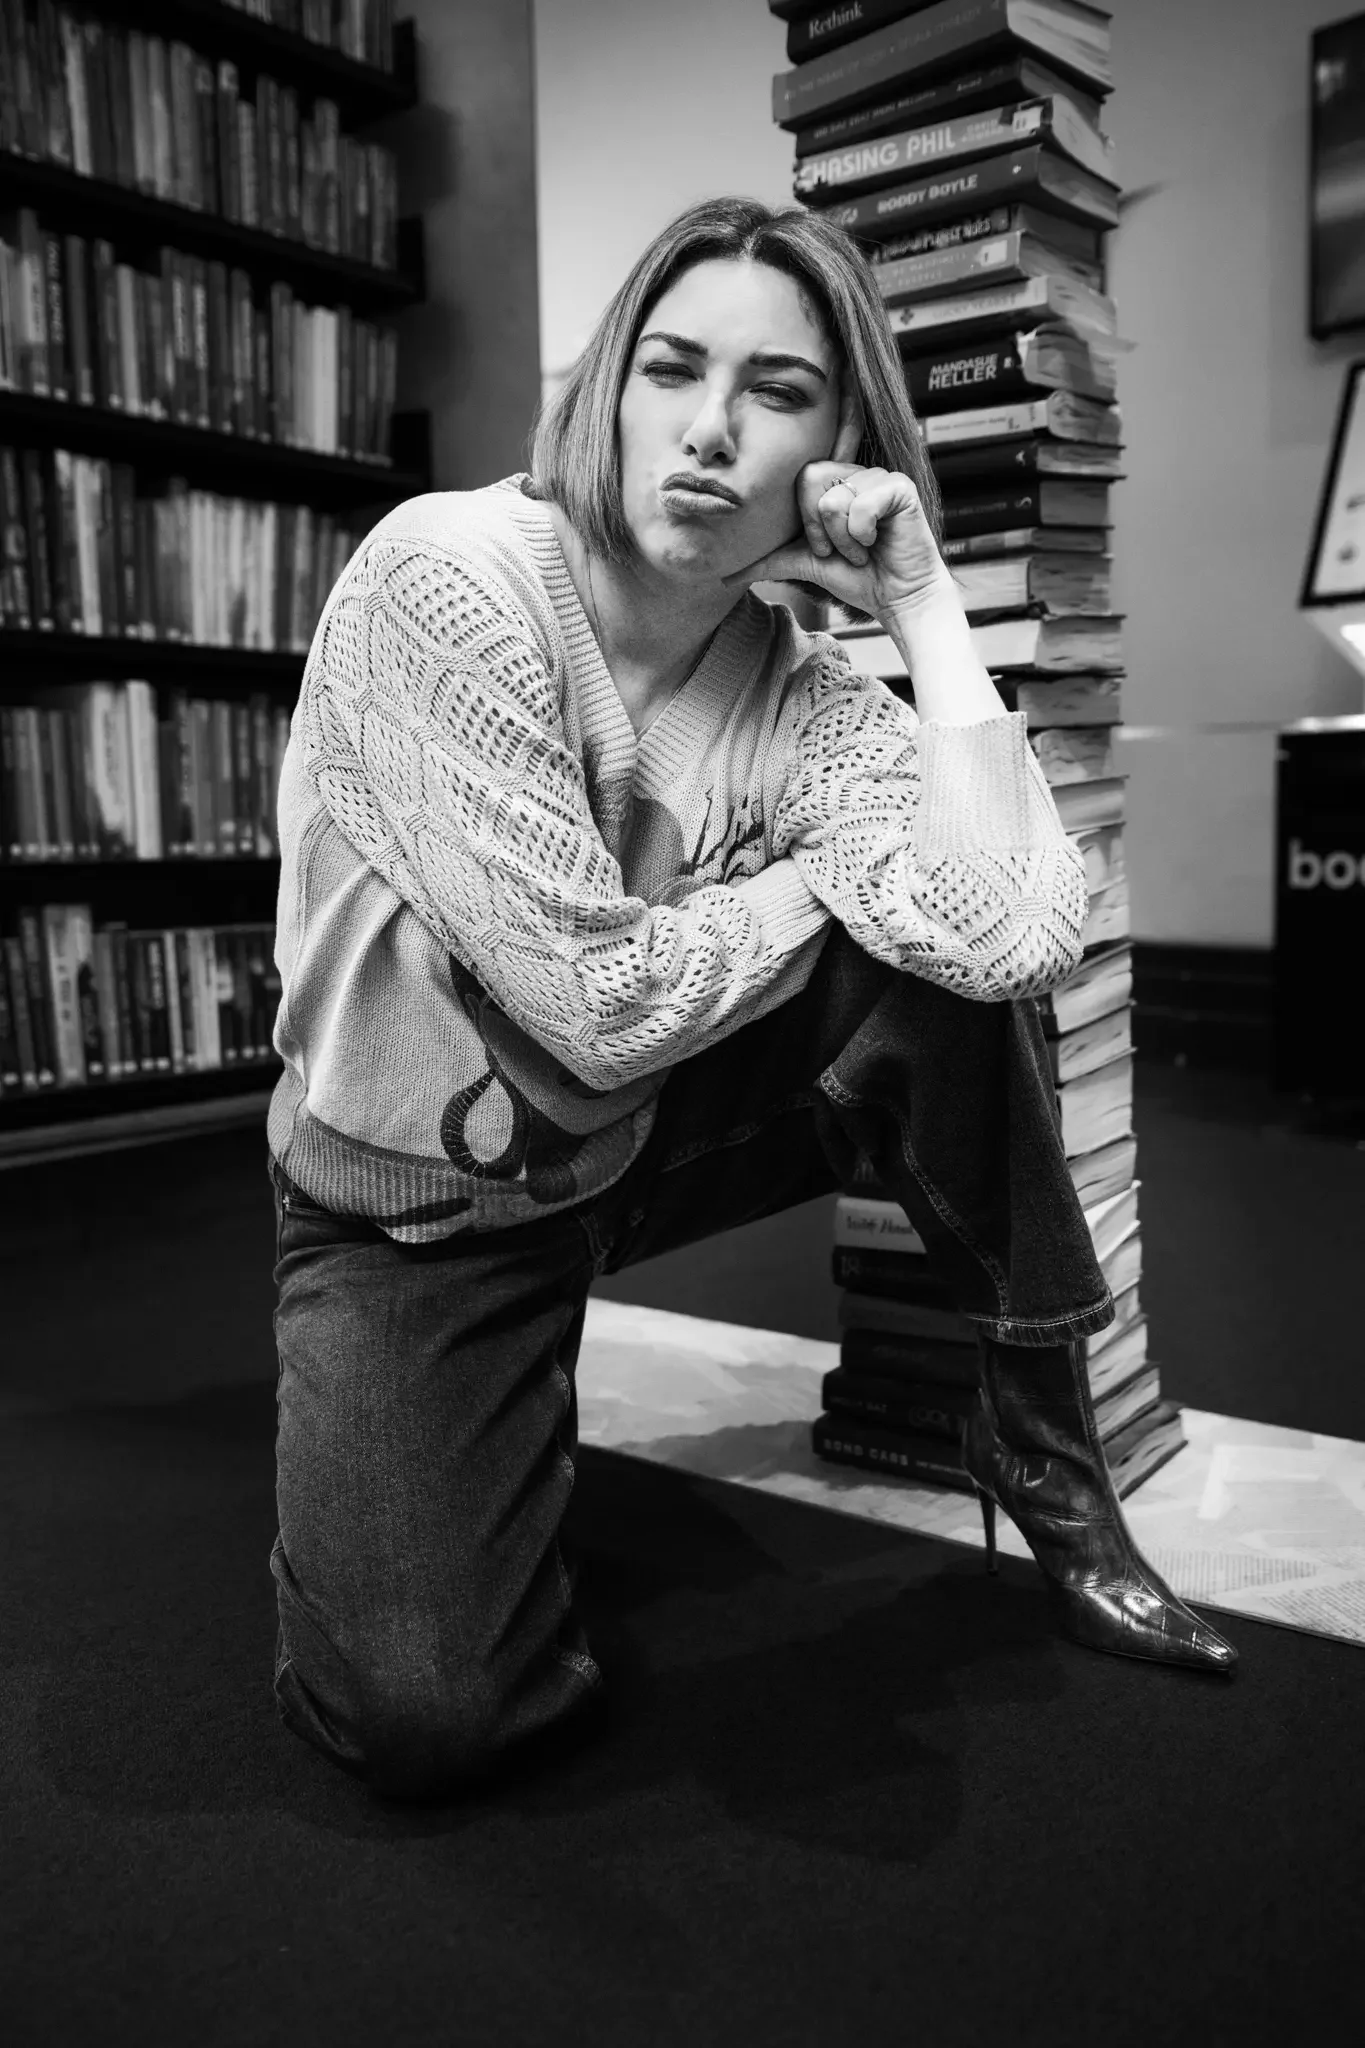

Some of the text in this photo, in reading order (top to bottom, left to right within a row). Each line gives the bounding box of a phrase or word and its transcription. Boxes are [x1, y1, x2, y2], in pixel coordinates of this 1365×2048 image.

[808, 1, 863, 39] Rethink
[798, 127, 956, 192] CHASING PHIL
[877, 189, 926, 215] RODDY
[931, 353, 999, 376] MANDASUE
[928, 366, 998, 392] HELLER
[1287, 836, 1365, 890] bo
[823, 1438, 908, 1466] BOND CARS
